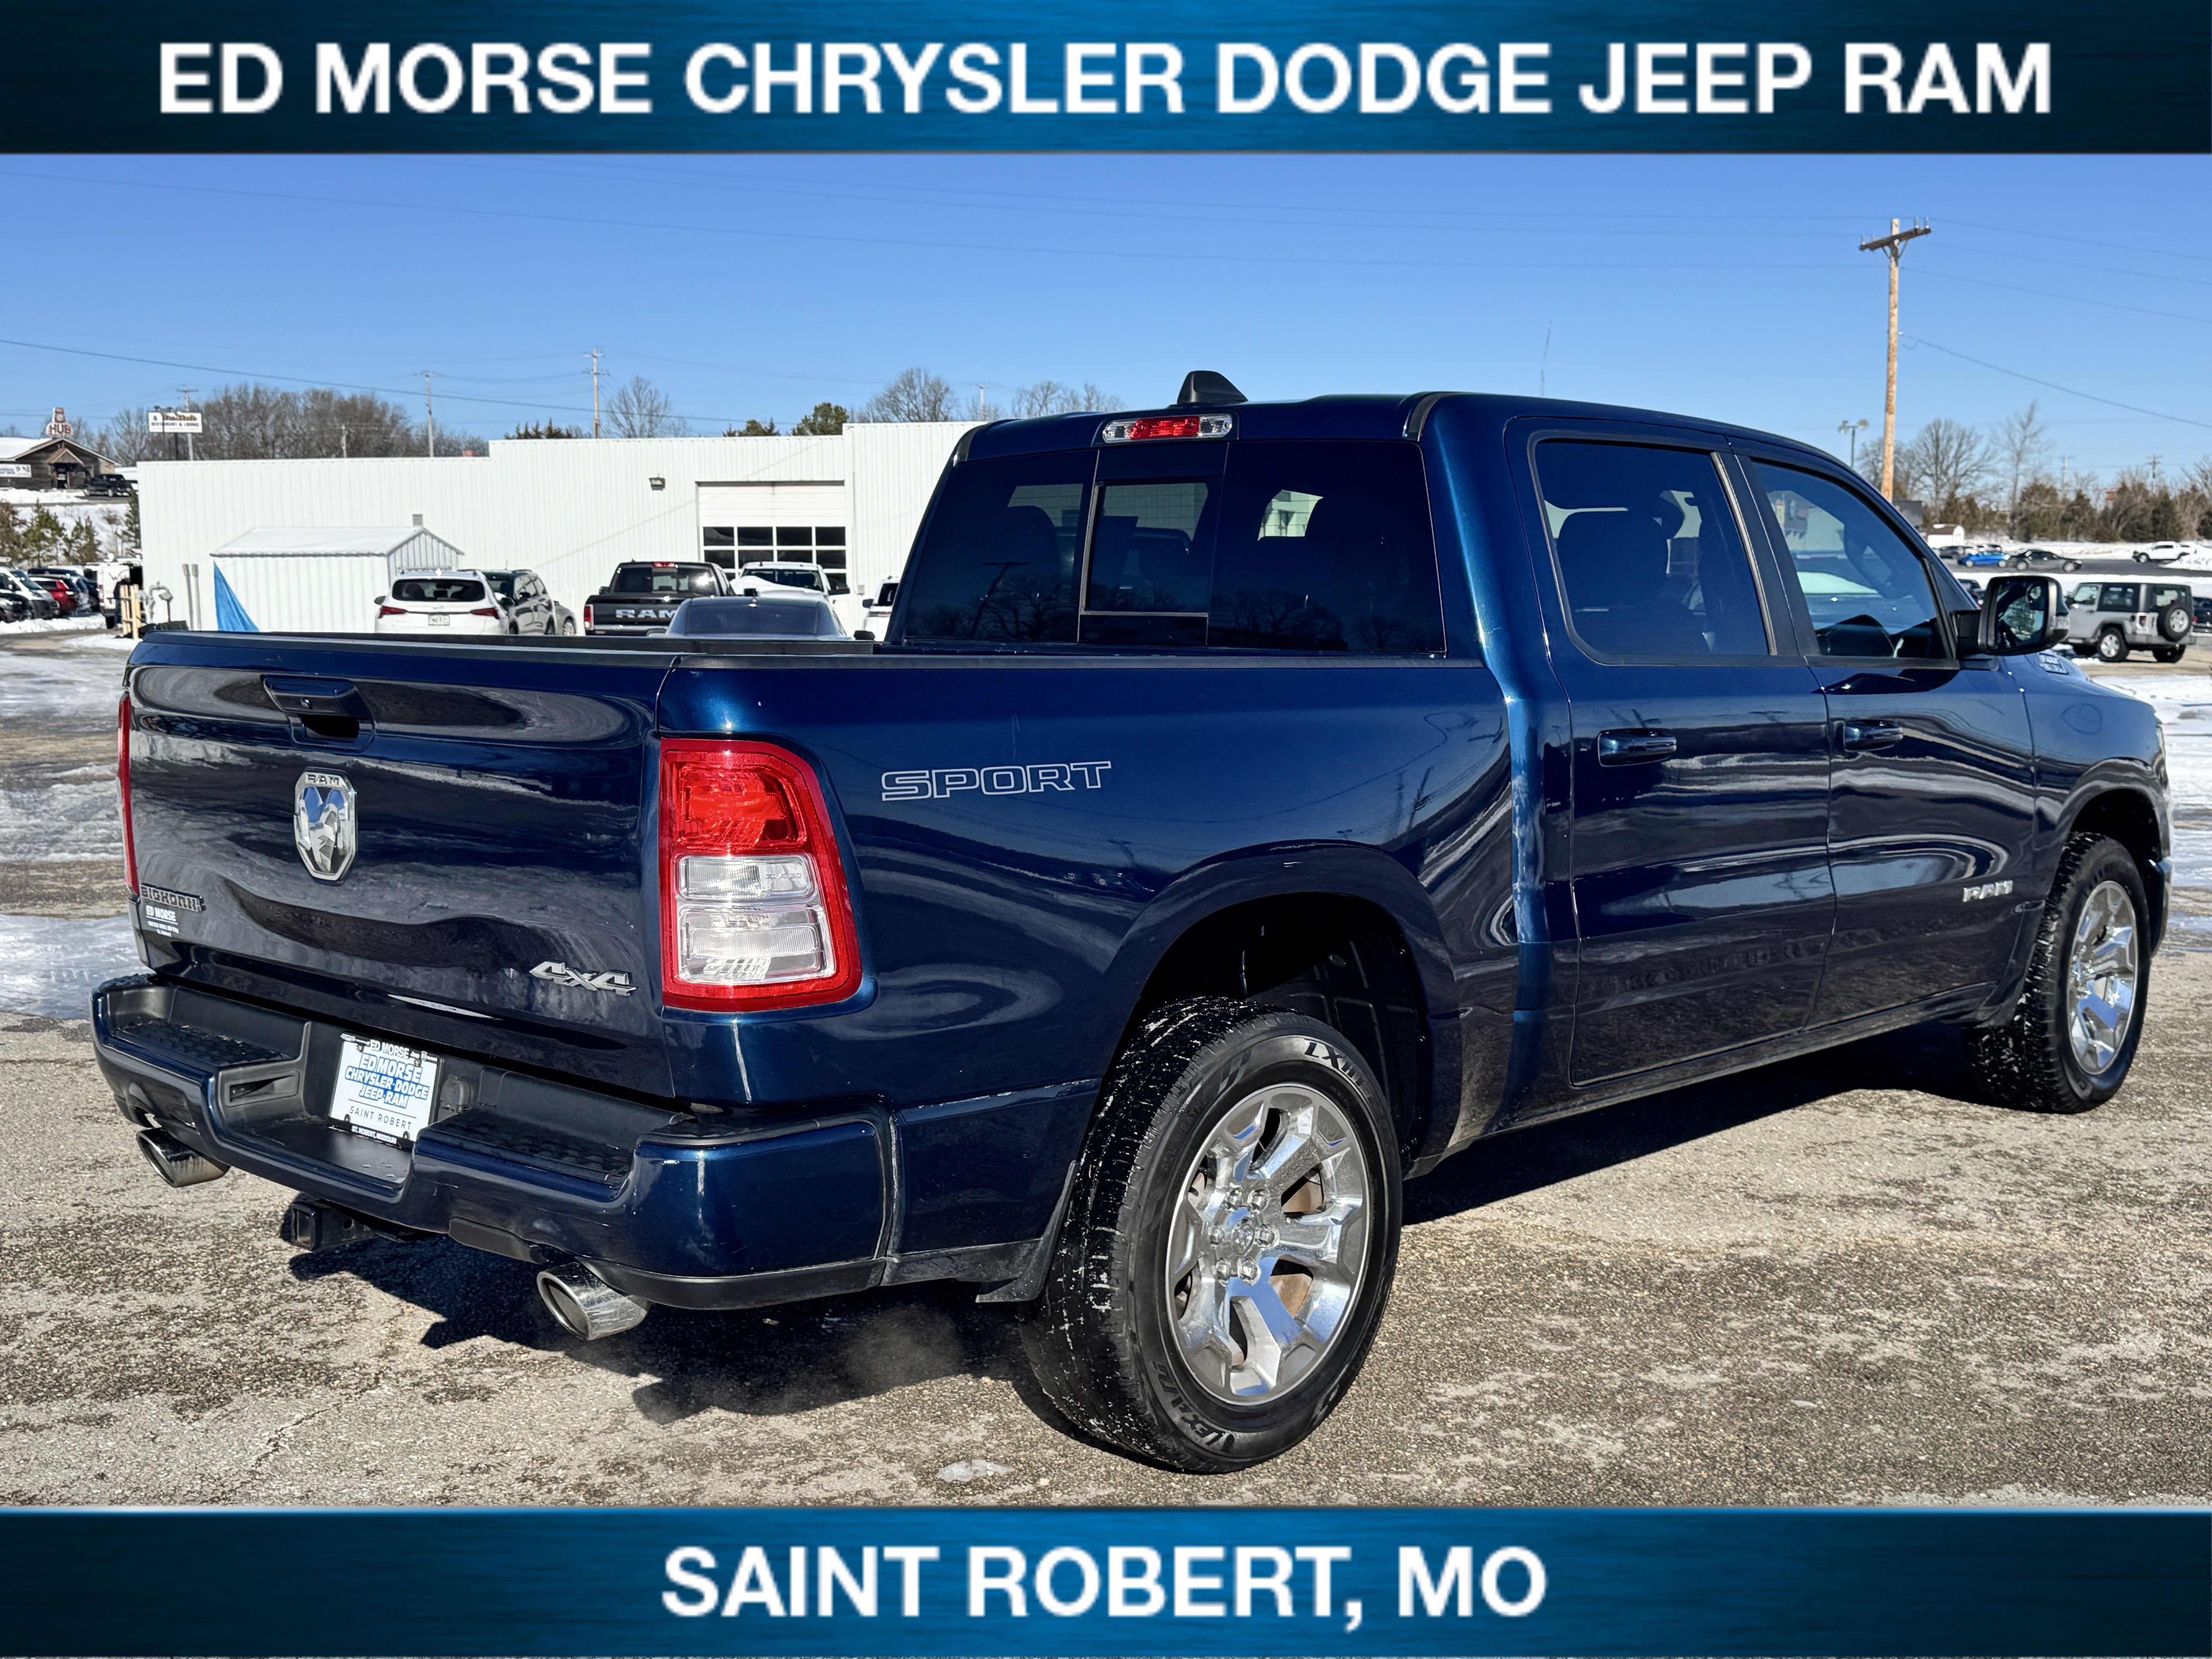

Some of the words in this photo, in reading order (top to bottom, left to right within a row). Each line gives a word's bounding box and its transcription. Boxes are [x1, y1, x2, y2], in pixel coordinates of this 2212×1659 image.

[50, 424, 71, 434] HUB
[615, 609, 677, 618] RAM
[307, 774, 340, 786] RAM
[881, 761, 1112, 801] SPORT
[1963, 880, 2013, 902] RAM
[146, 905, 154, 916] ED
[155, 907, 176, 922] MORSE
[370, 1039, 381, 1051] ED
[382, 1042, 410, 1059] MORSE
[359, 1053, 378, 1072] ED
[376, 1057, 423, 1083] MORSE
[350, 1106, 374, 1119] SAINT
[378, 1113, 412, 1130] ROBERT
